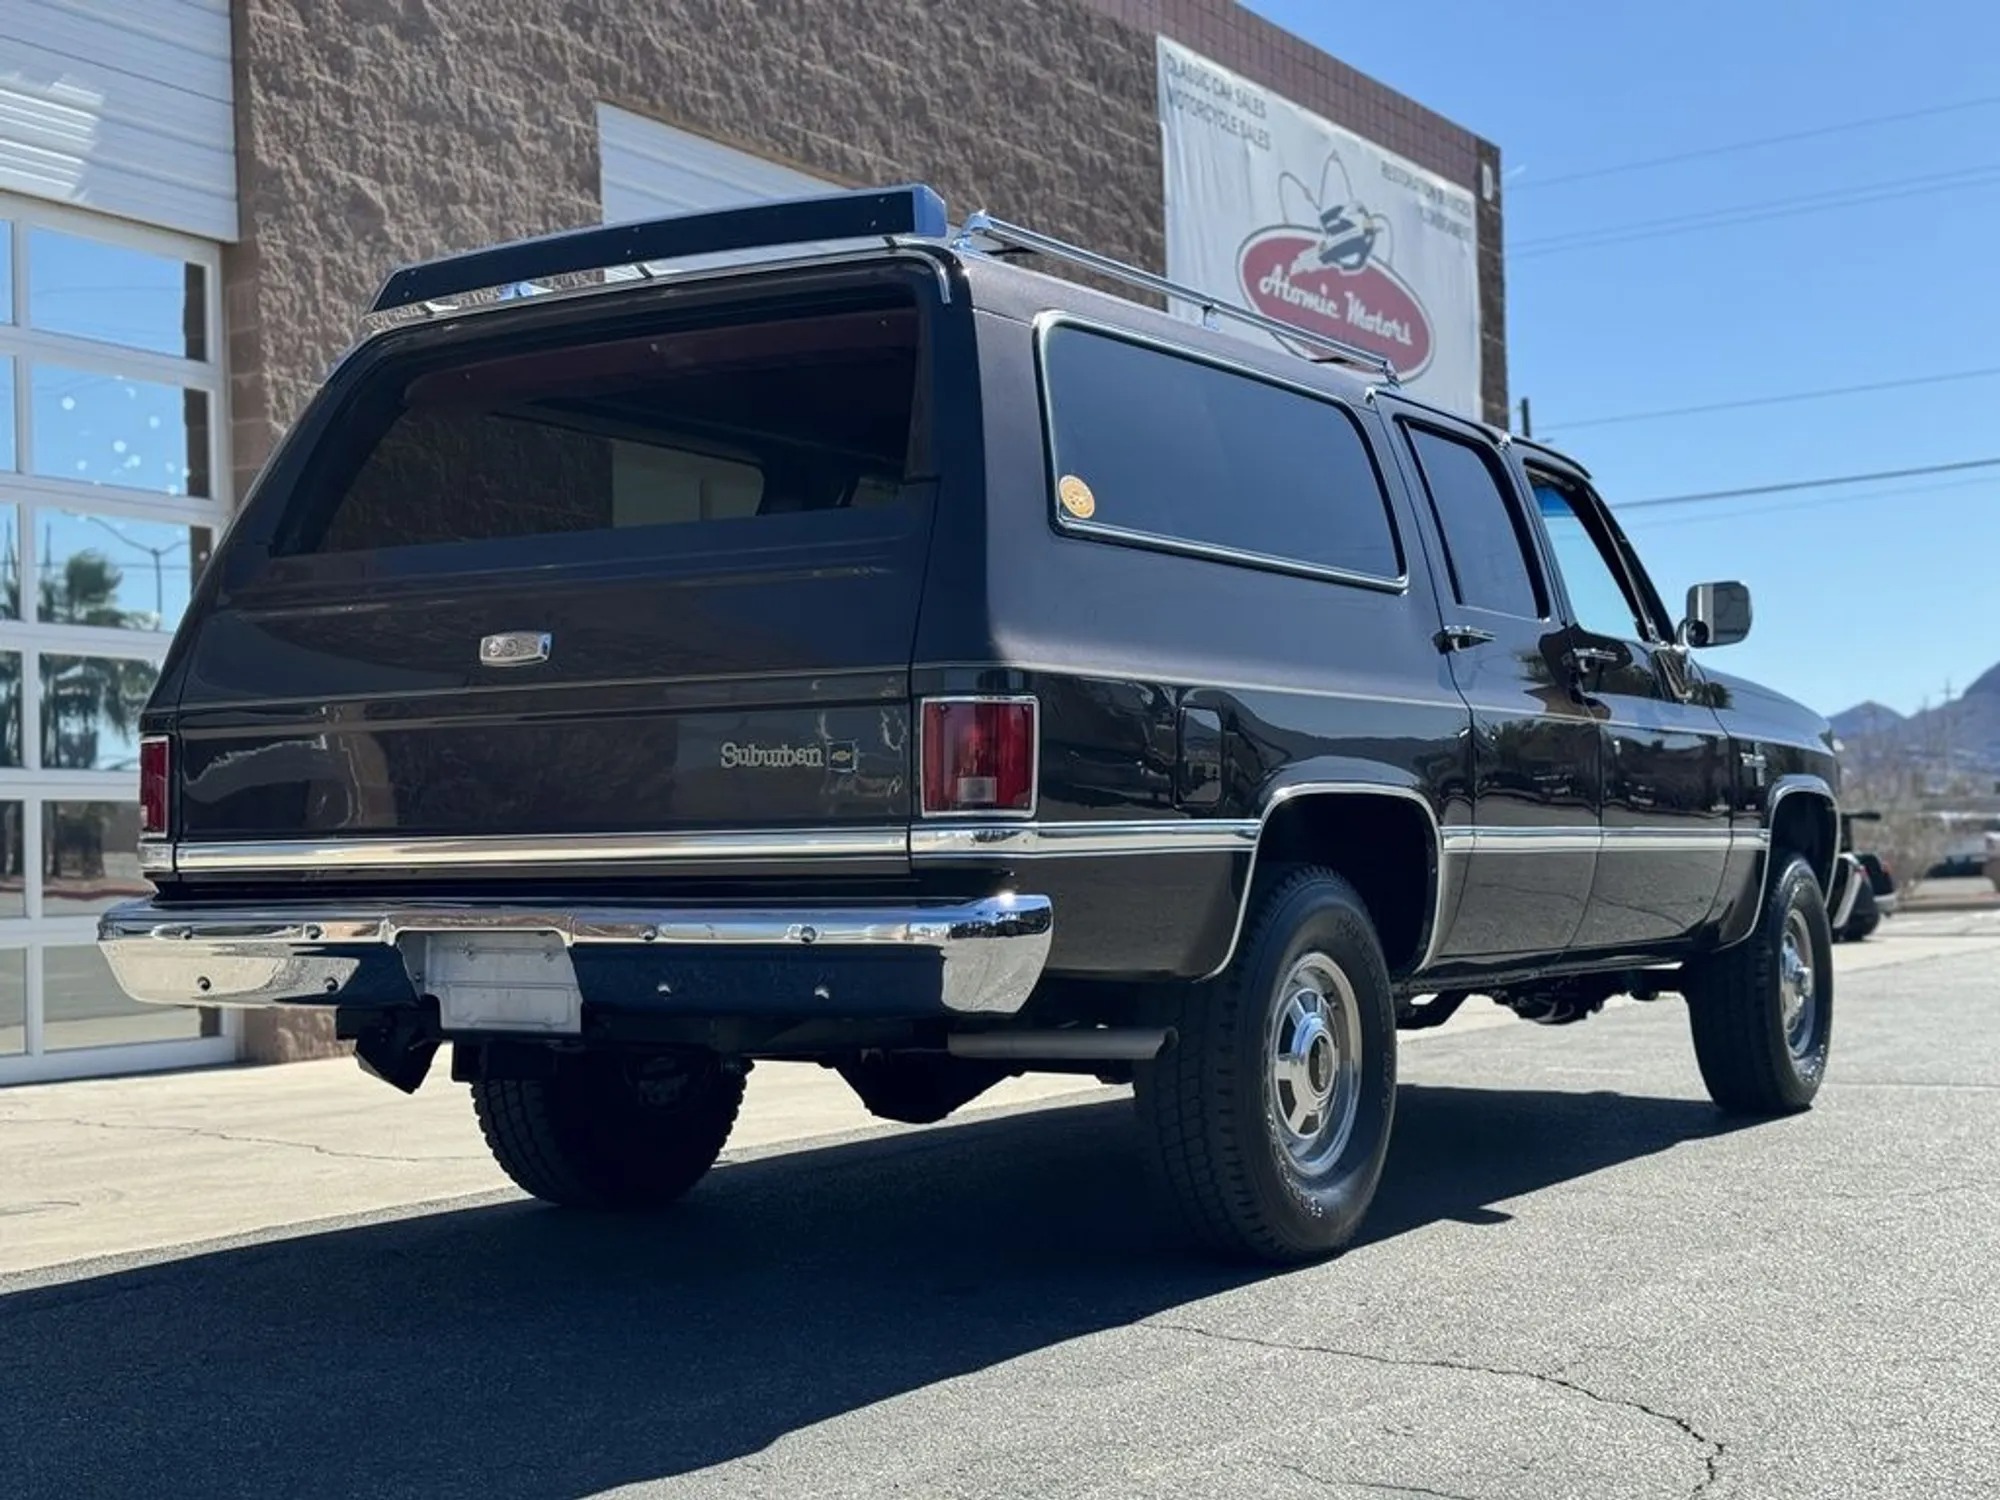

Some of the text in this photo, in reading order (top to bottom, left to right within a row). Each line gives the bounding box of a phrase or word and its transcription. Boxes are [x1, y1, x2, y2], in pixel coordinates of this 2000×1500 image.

[1212, 76, 1233, 101] CAR
[1235, 88, 1267, 119] SALES
[1240, 120, 1271, 152] SALES
[1259, 264, 1413, 346] Atomic Motors
[720, 742, 824, 768] Suburban
